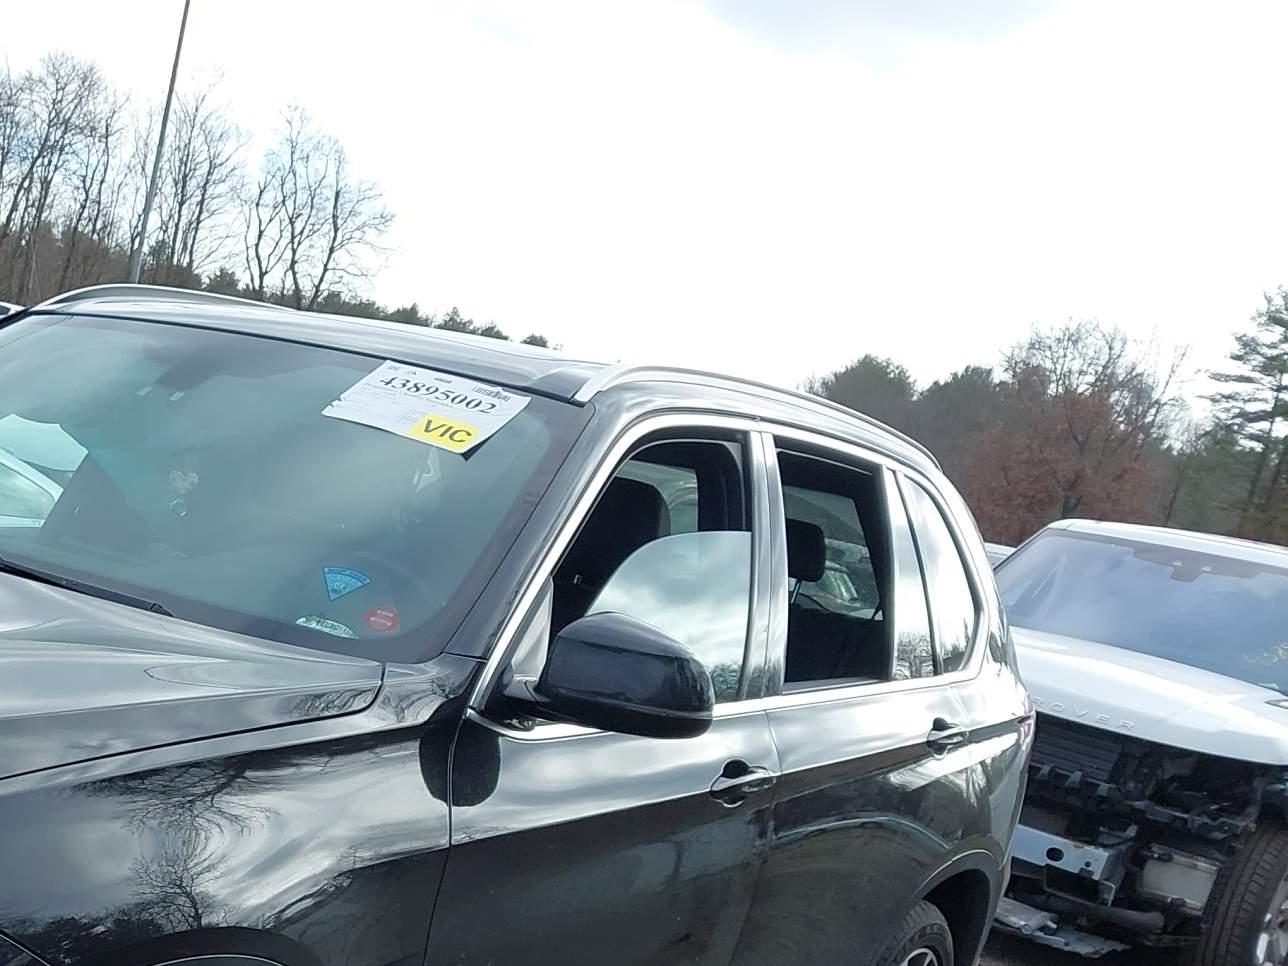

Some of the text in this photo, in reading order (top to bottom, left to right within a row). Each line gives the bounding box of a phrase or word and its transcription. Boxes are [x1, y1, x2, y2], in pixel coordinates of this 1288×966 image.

[379, 375, 498, 415] 43895002
[423, 418, 472, 443] VIC
[1031, 695, 1135, 729] ROVER
